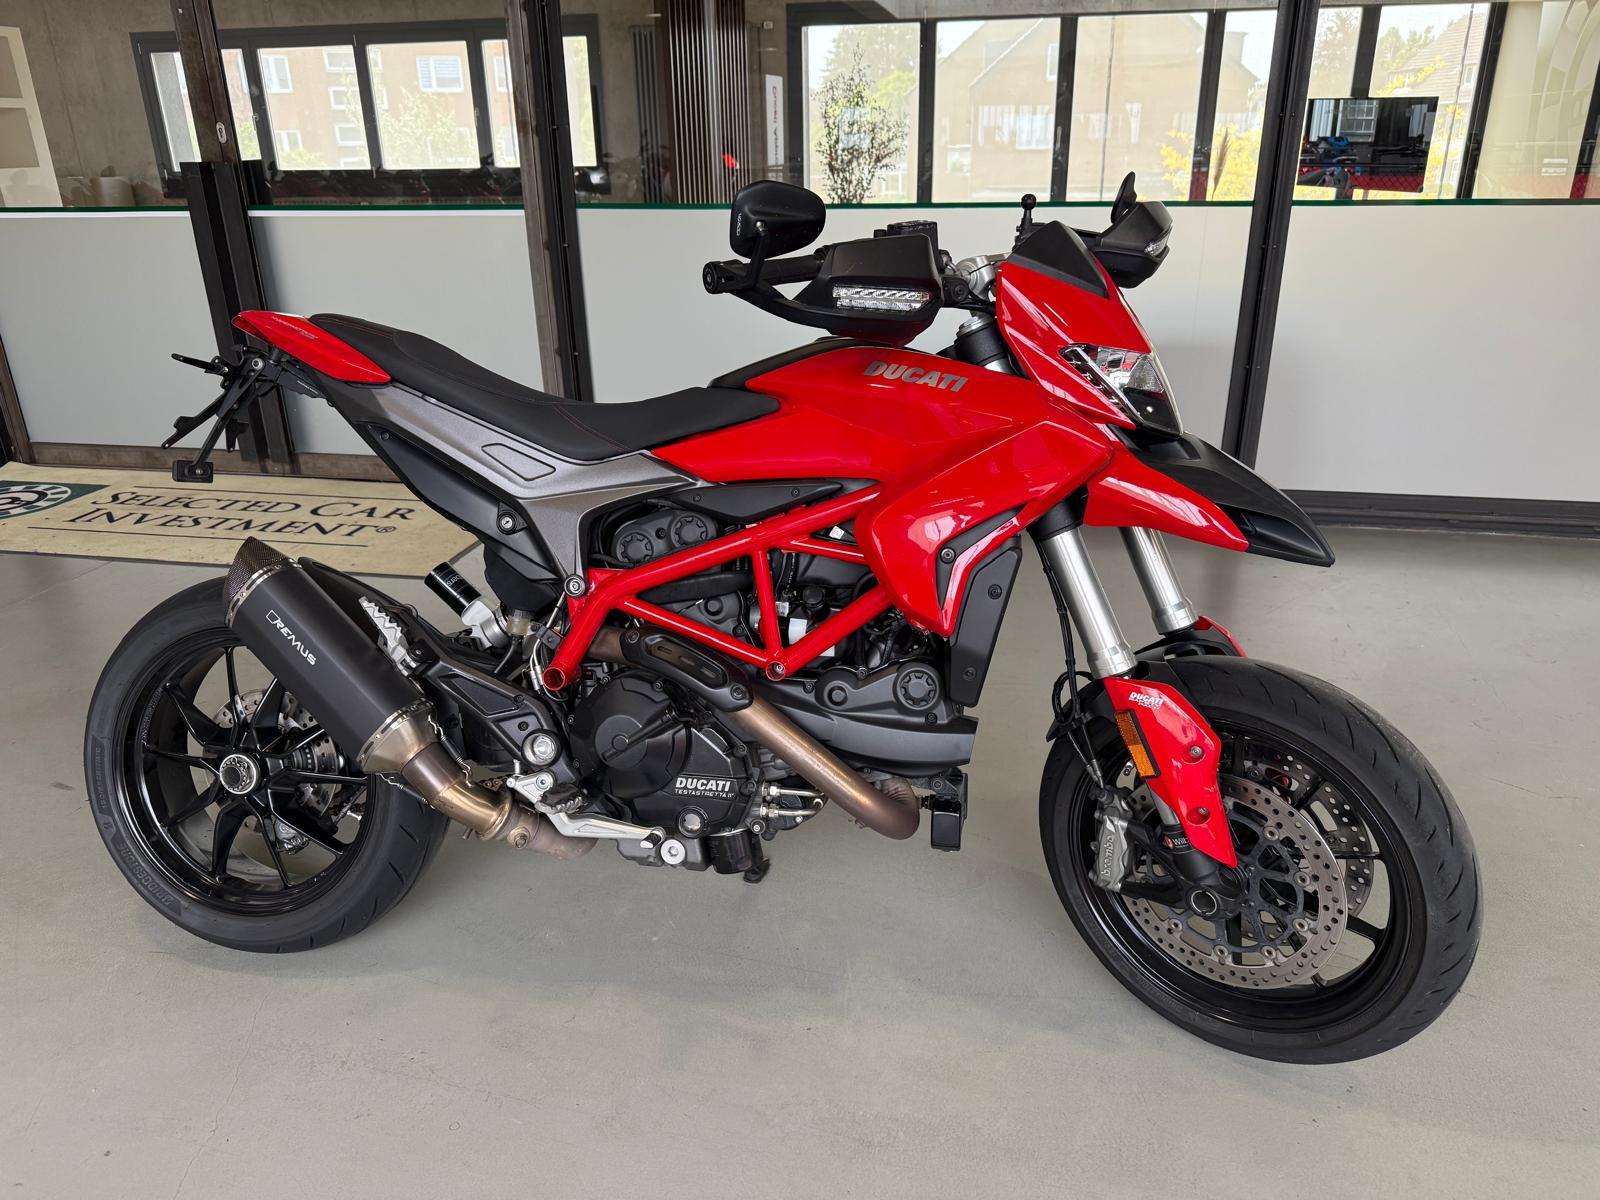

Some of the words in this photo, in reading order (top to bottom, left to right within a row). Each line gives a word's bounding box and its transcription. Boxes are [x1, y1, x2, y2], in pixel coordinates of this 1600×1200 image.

[863, 360, 969, 392] DUCATI
[91, 491, 302, 513] SELECTED
[309, 502, 416, 520] CAR
[270, 618, 317, 666] REMUS
[1129, 691, 1164, 705] DUCATI
[674, 788, 726, 798] TESTASTRETTA
[675, 777, 731, 792] DUCATI
[1100, 835, 1114, 877] brembo
